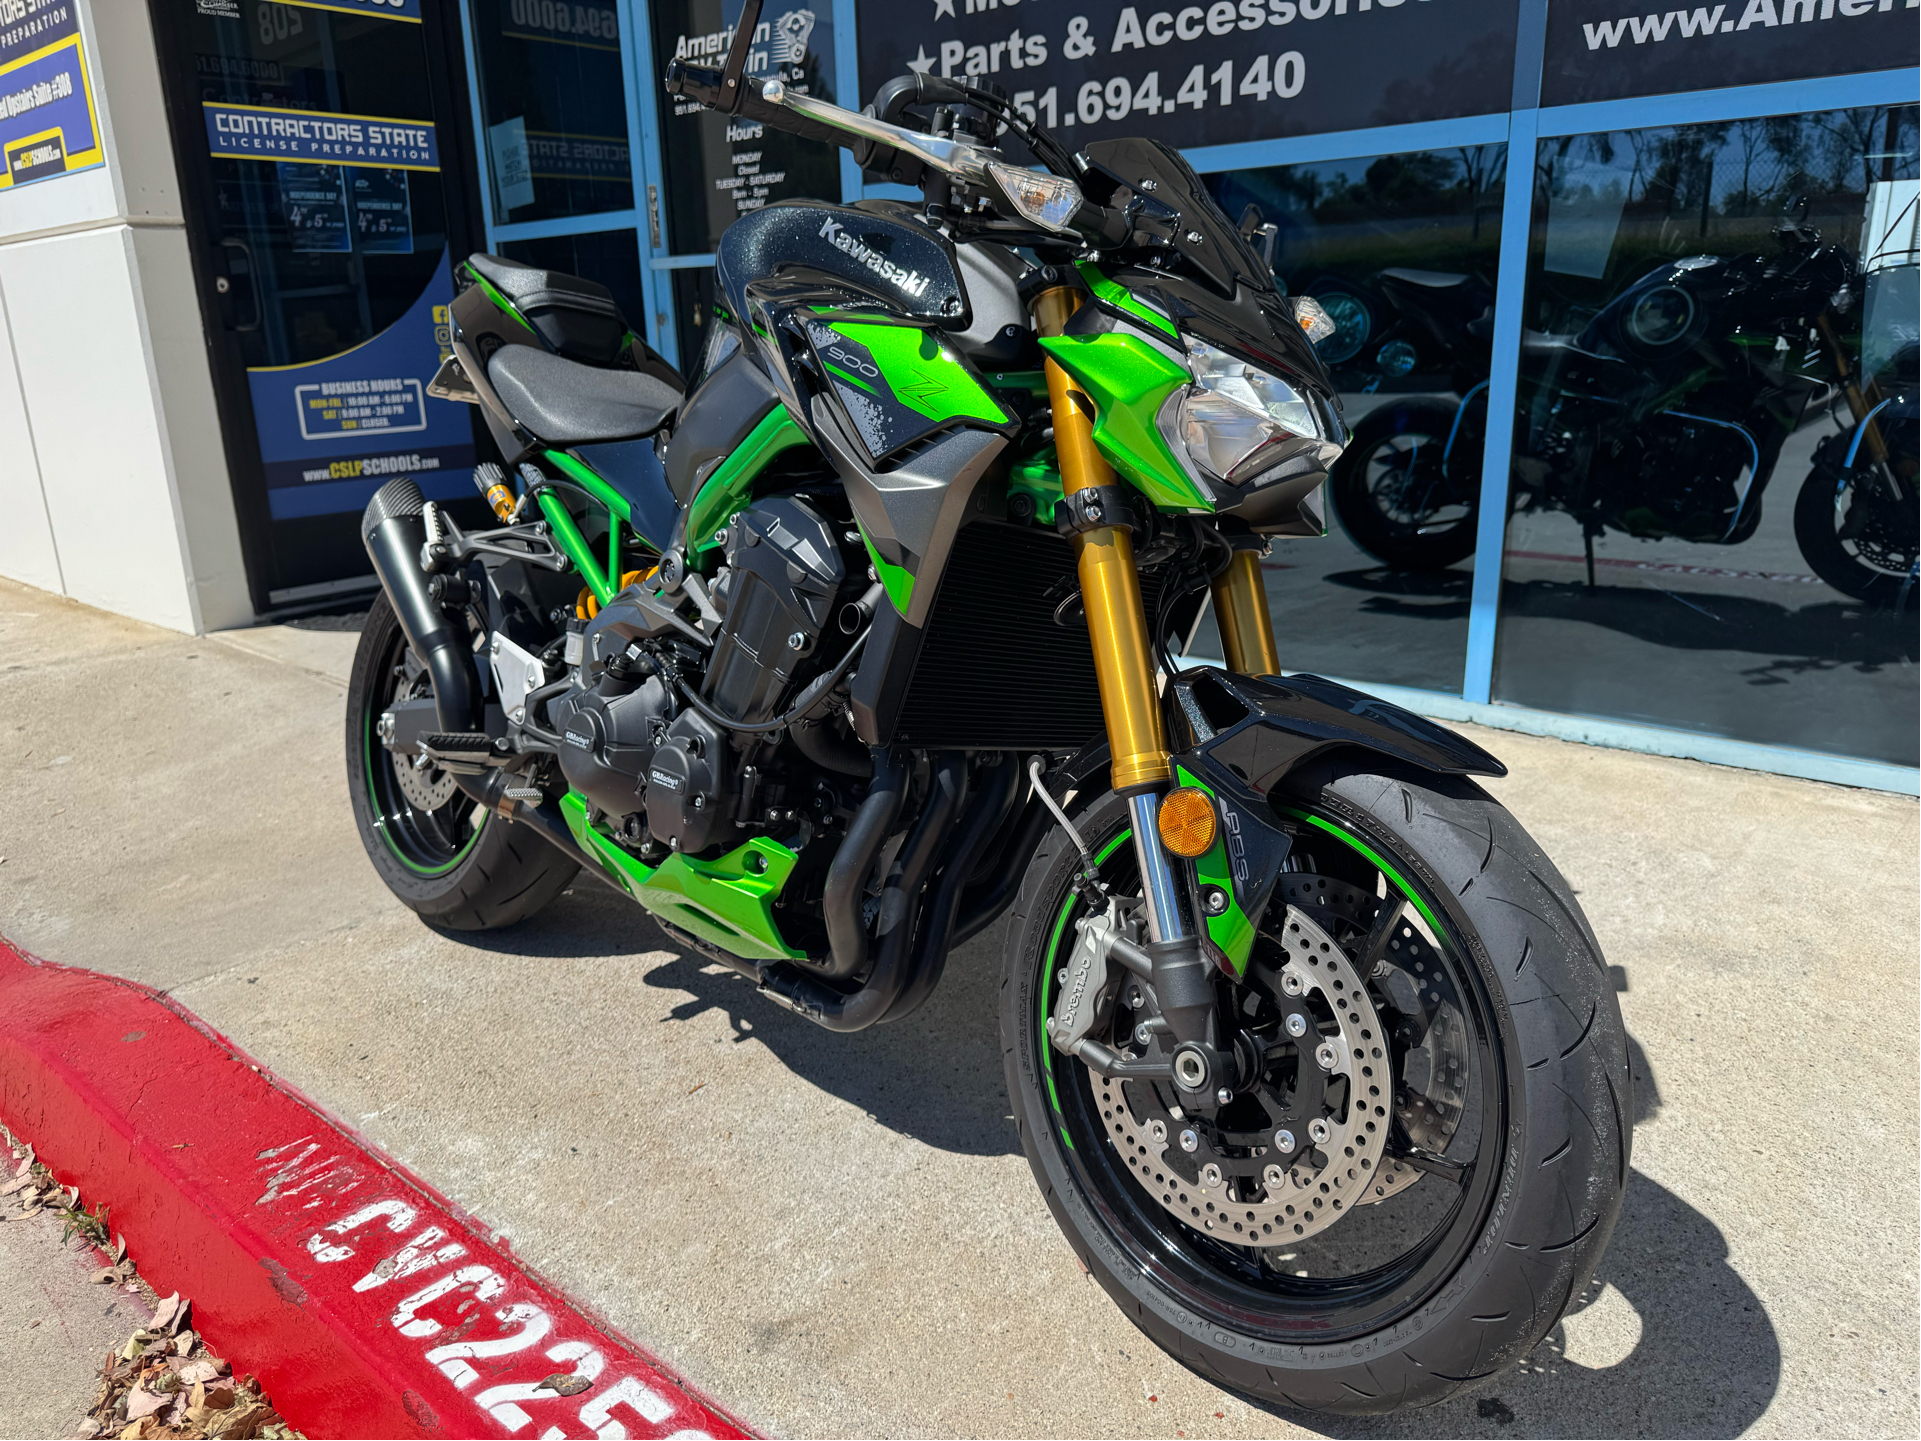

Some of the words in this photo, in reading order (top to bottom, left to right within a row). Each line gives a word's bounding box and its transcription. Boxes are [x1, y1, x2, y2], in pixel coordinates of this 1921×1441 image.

[0, 6, 67, 48] PREPARATION
[675, 21, 771, 59] Amerin
[941, 28, 1048, 80] Parts
[1063, 16, 1096, 60] &
[6, 94, 36, 117] Upstairs
[32, 82, 53, 107] Suite
[51, 71, 72, 100] #308
[996, 50, 1306, 138] 51.694.4140
[215, 113, 363, 143] CONTRACTORS
[368, 126, 428, 148] STATE
[726, 125, 764, 143] Hours
[219, 136, 299, 151] LICENSE
[311, 143, 430, 160] PREPARATION
[732, 151, 762, 165] MONDAY
[715, 177, 746, 190] TUESDAY
[749, 171, 786, 186] SATURDAY
[738, 163, 760, 176] Closed
[737, 198, 766, 210] SUNDAY
[818, 216, 930, 297] Kawasaki
[827, 347, 879, 378] 900
[321, 379, 370, 396] BUSINESS
[370, 378, 403, 392] HOURS
[347, 396, 369, 407] 10:00
[369, 395, 380, 406] AM
[402, 392, 414, 403] PM
[323, 409, 337, 420] SAT
[360, 407, 371, 418] AM
[393, 404, 404, 415] PM
[341, 419, 357, 430] SUN
[1226, 811, 1248, 882] ABS
[1061, 956, 1092, 1027] brembo
[306, 1199, 707, 1441] CVC225
